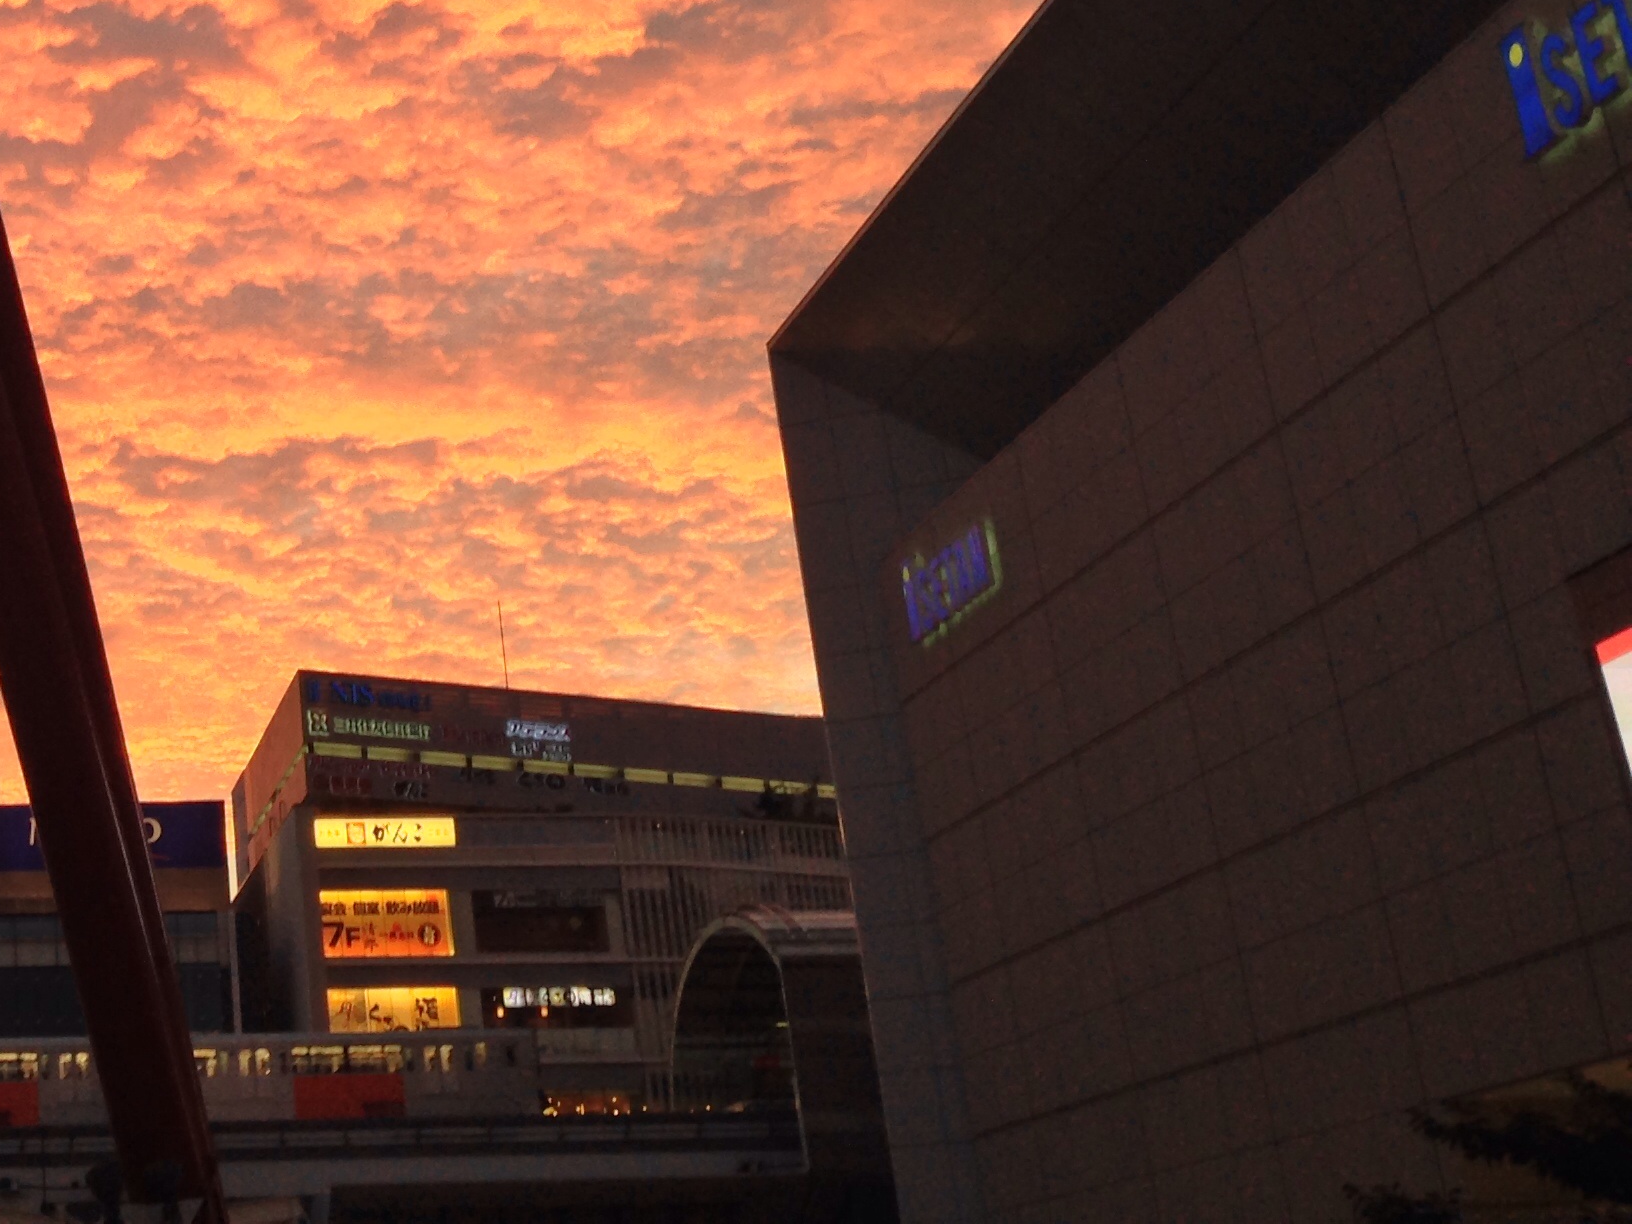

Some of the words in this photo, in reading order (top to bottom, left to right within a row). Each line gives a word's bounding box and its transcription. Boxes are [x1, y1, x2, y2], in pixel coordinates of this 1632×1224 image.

[372, 823, 423, 843] がんこ
[323, 922, 361, 949] 7F
